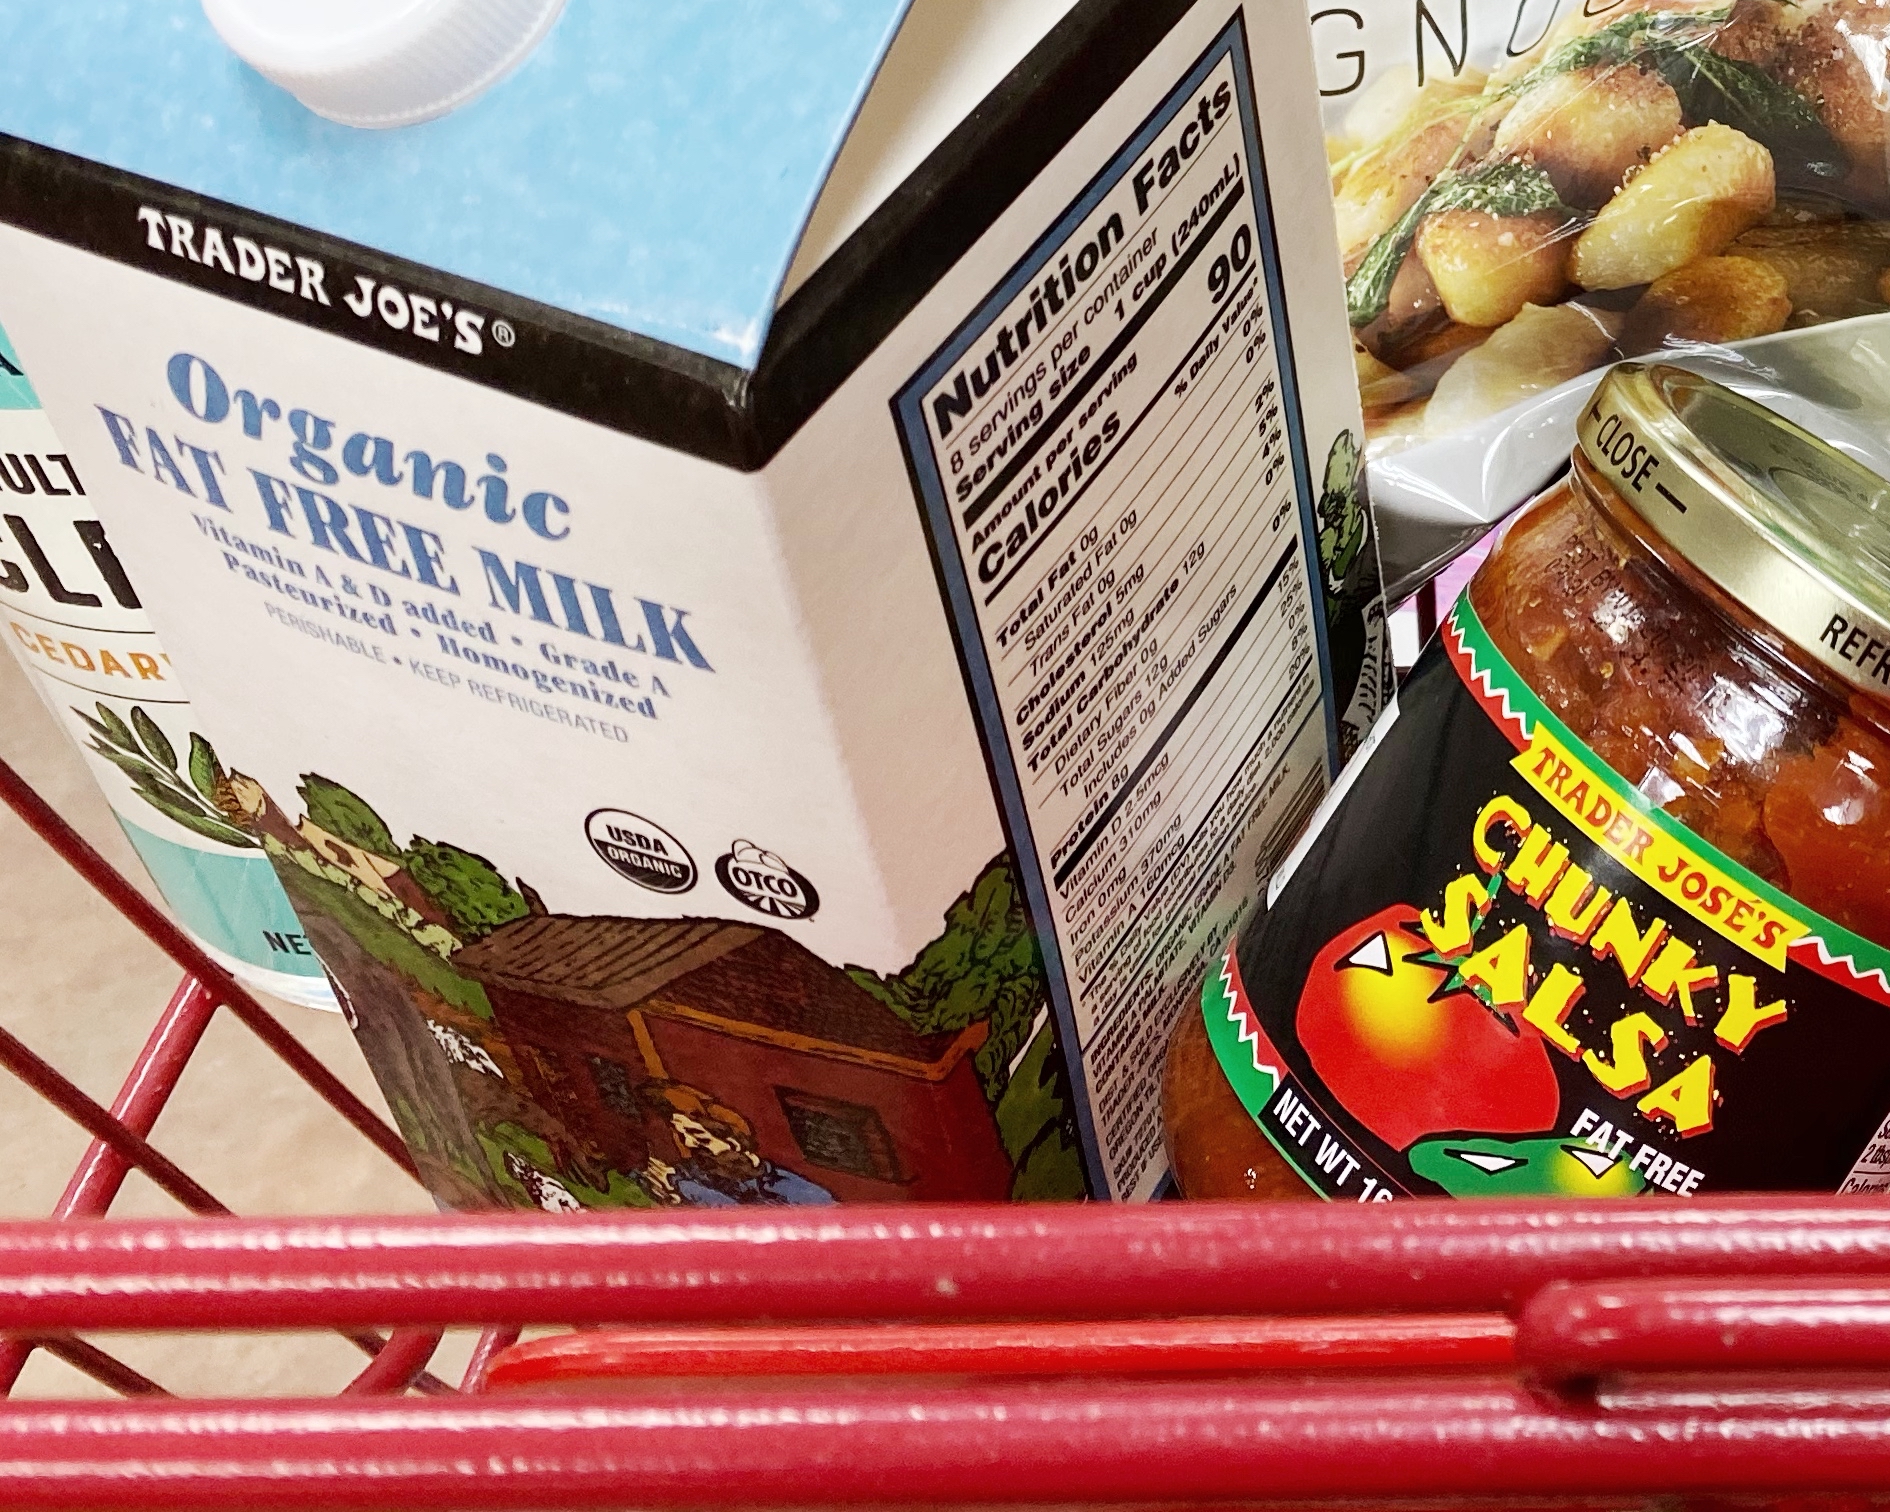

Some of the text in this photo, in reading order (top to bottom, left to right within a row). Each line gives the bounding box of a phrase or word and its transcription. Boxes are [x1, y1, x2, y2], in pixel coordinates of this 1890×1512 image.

[138, 206, 331, 306] TRADER
[933, 81, 1230, 439] Nutrition Facts
[950, 227, 1157, 473] 8 servings per container
[956, 152, 1242, 502] Serving size 1 cup (240mL)
[167, 352, 571, 541] Organic
[978, 224, 1251, 583] Calories 90
[1190, 334, 1219, 380] Daily
[94, 403, 233, 512] FAT
[246, 465, 460, 595] FREE
[472, 546, 716, 673] MILK
[972, 352, 1136, 553] Amount per serving
[996, 303, 1262, 646] Total Fat 0g 0%
[1024, 329, 1265, 650] Saturated Fat 0g 0%
[1596, 412, 1660, 492] CLOSE
[191, 512, 672, 697] Vitamin A & D added Grade A
[221, 550, 399, 635] Pasteurized
[438, 632, 658, 721] Homogenized
[1016, 379, 1273, 725] Cholesterol 5mg 2%
[1022, 403, 1277, 750] Sodium 125mg 5%
[1027, 427, 1281, 771] Total Carbohydrate 12g 4%
[1055, 452, 1284, 774] Dietary Fiber 0g 0%
[263, 601, 629, 744] PERISHABLE KEEP REFRIGERATED
[606, 824, 669, 856] USDA
[607, 846, 683, 879] ORGANIC
[732, 867, 797, 898] OTCO
[1051, 764, 1128, 869] Protein 8g
[1531, 747, 1655, 866] TRADER
[263, 930, 312, 955] NE
[1420, 873, 1715, 1139] SALSA
[1472, 795, 1788, 1055] CHUNKY
[1272, 1088, 1321, 1147] NET
[1314, 1133, 1361, 1187] WT
[1570, 1108, 1706, 1198] FAT FREE
